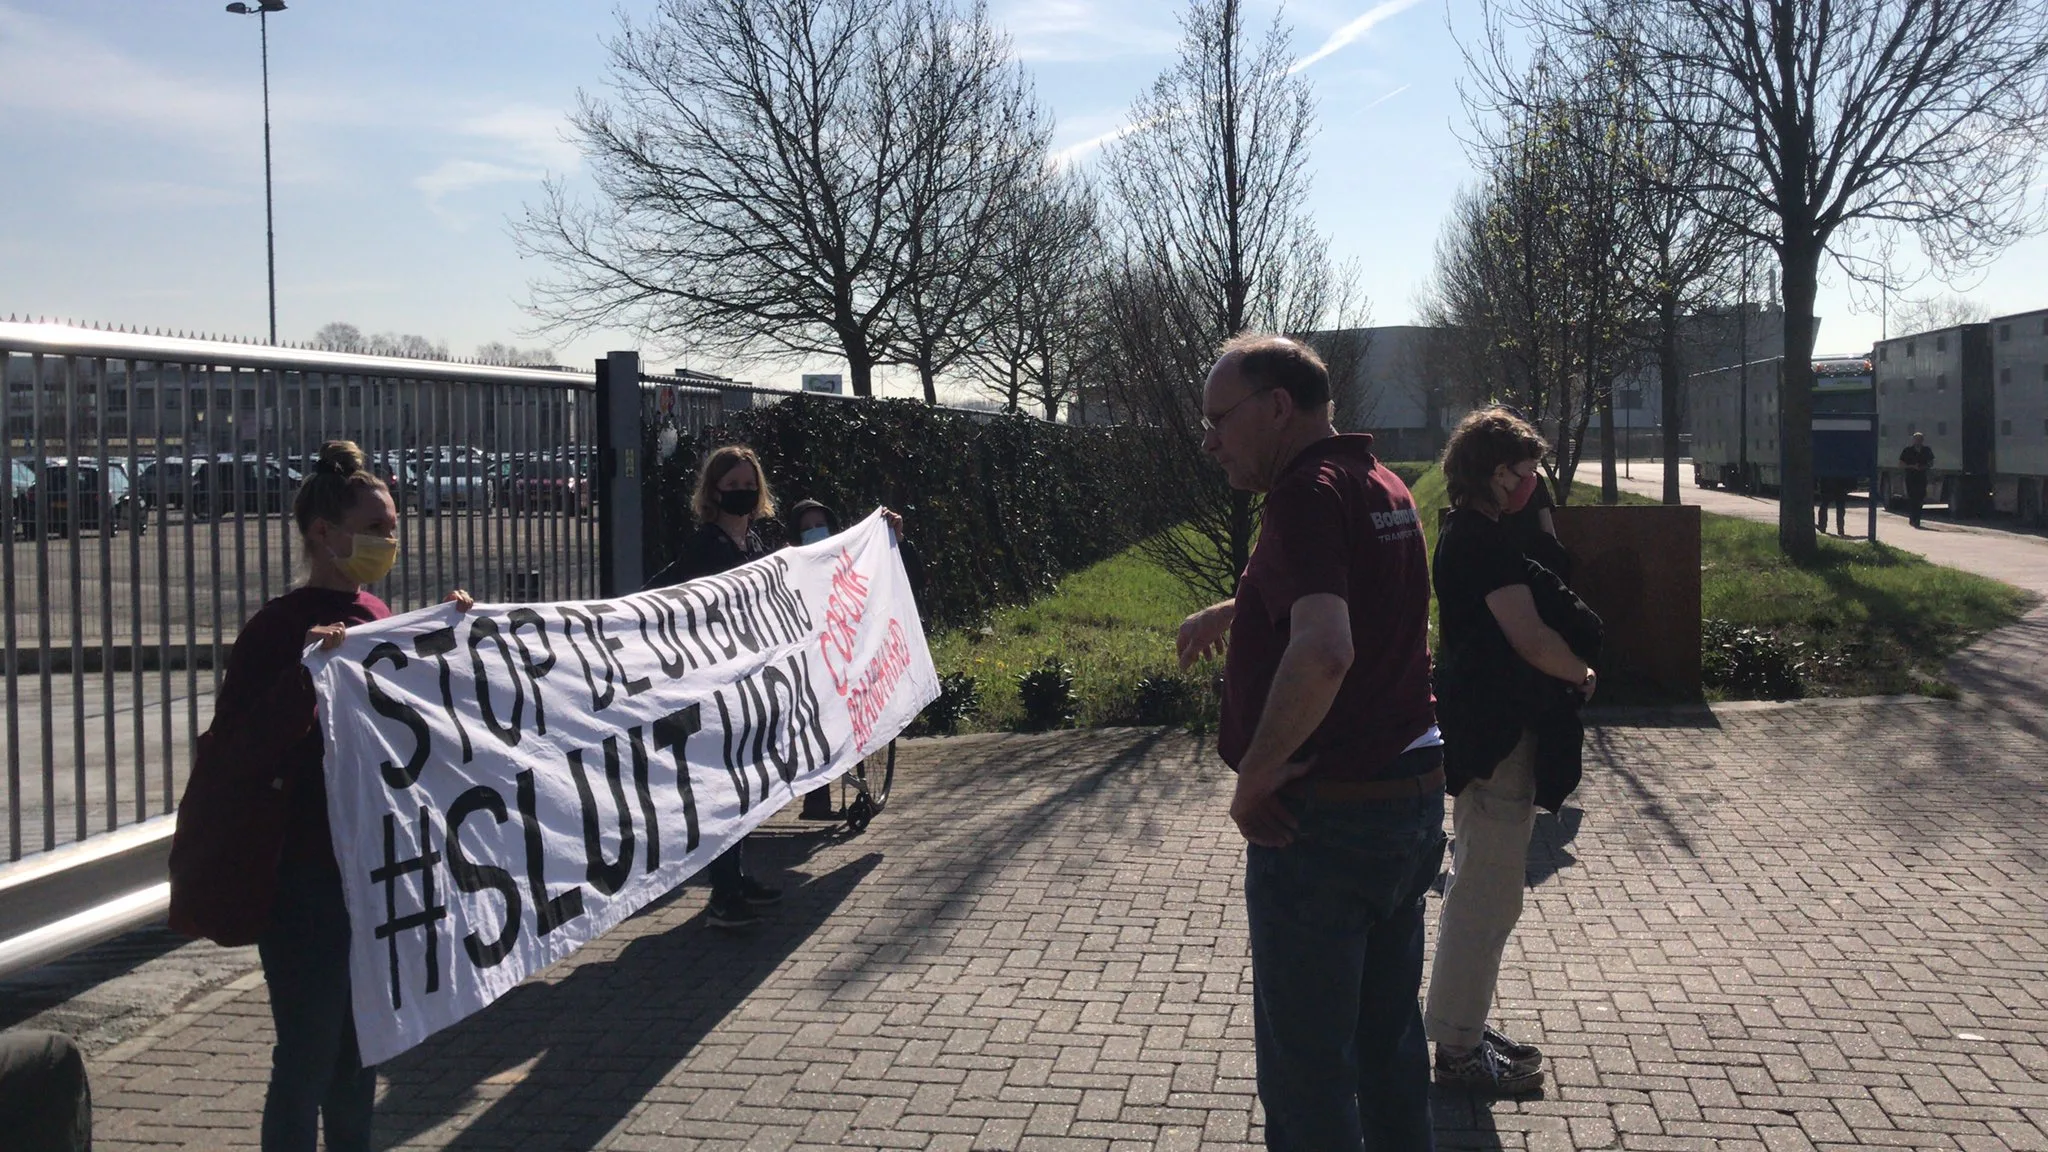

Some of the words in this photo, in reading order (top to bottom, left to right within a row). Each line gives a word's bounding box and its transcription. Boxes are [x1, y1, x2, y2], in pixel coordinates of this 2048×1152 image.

[363, 607, 556, 789] STOP
[557, 604, 652, 712] DE
[622, 556, 812, 679] UITBUITING
[820, 546, 868, 696] CORONA
[370, 702, 700, 1010] #SLUIT
[713, 651, 829, 816] VION
